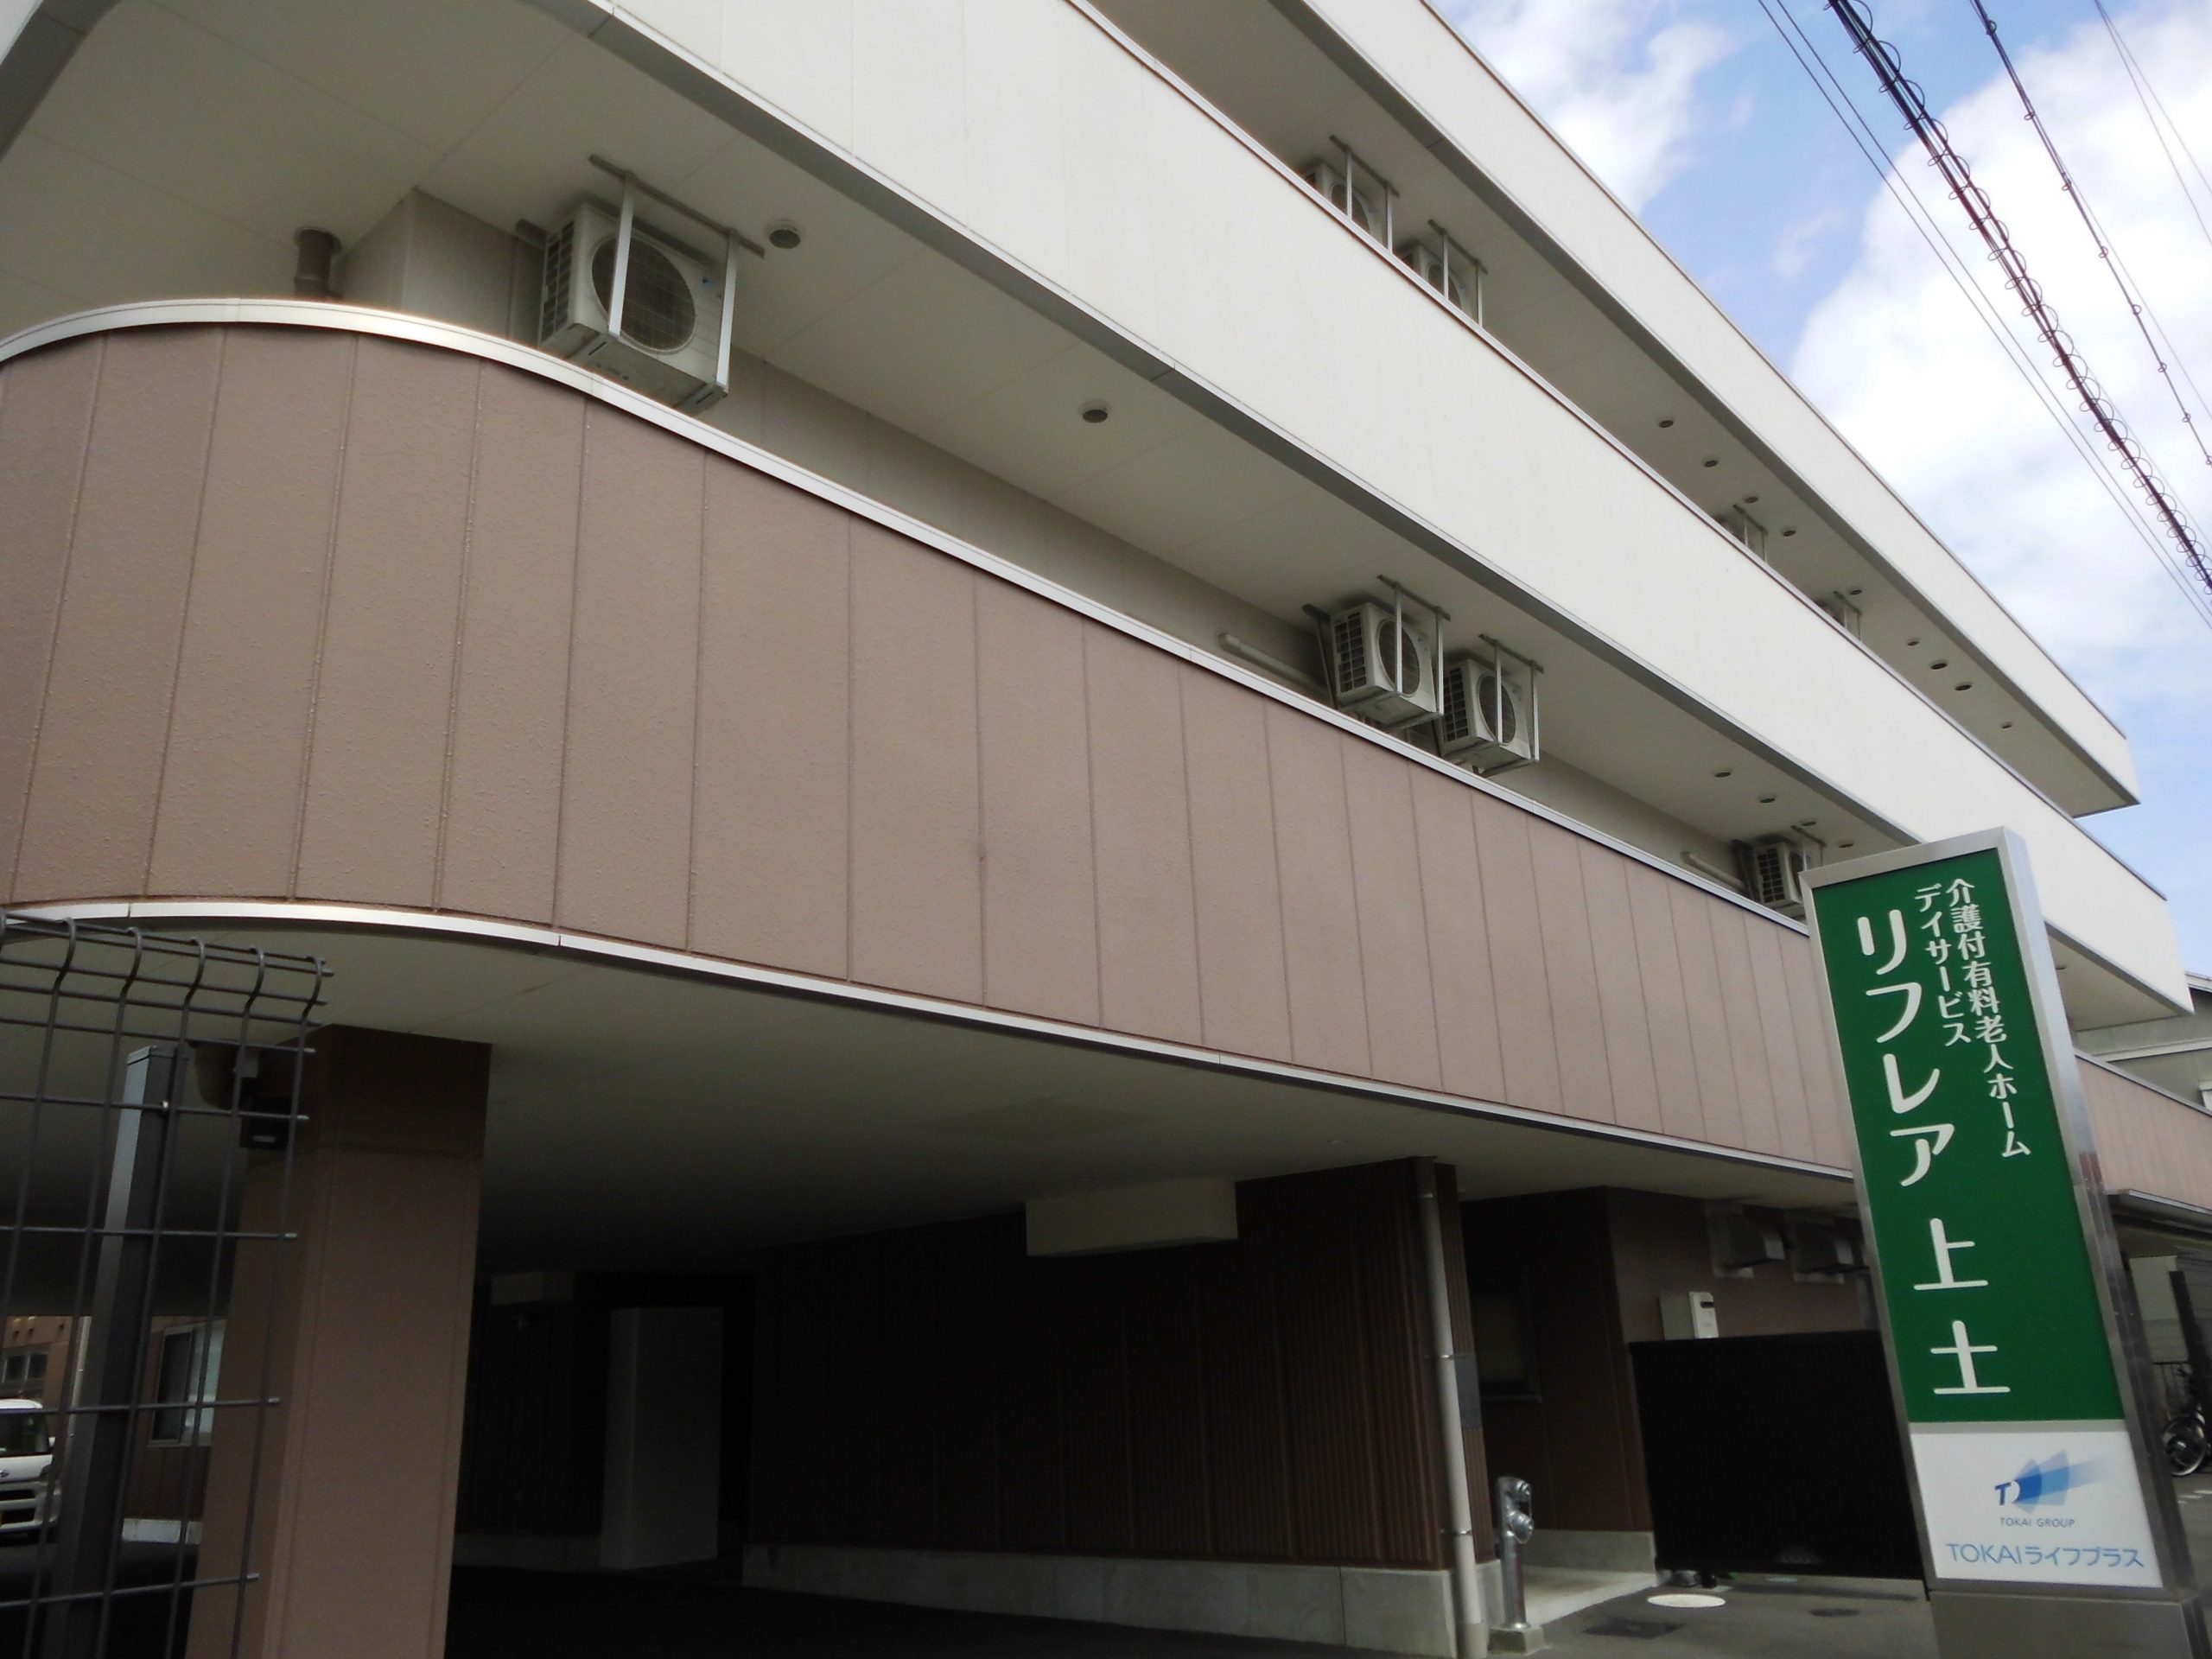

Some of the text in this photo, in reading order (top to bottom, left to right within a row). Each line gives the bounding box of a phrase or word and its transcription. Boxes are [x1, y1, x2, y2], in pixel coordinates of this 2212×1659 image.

[1915, 883, 1972, 1048] デイサービス
[1946, 878, 2031, 1158] 介護付有料老人ホーム
[2000, 1516, 2075, 1529] TOKAI GROUP
